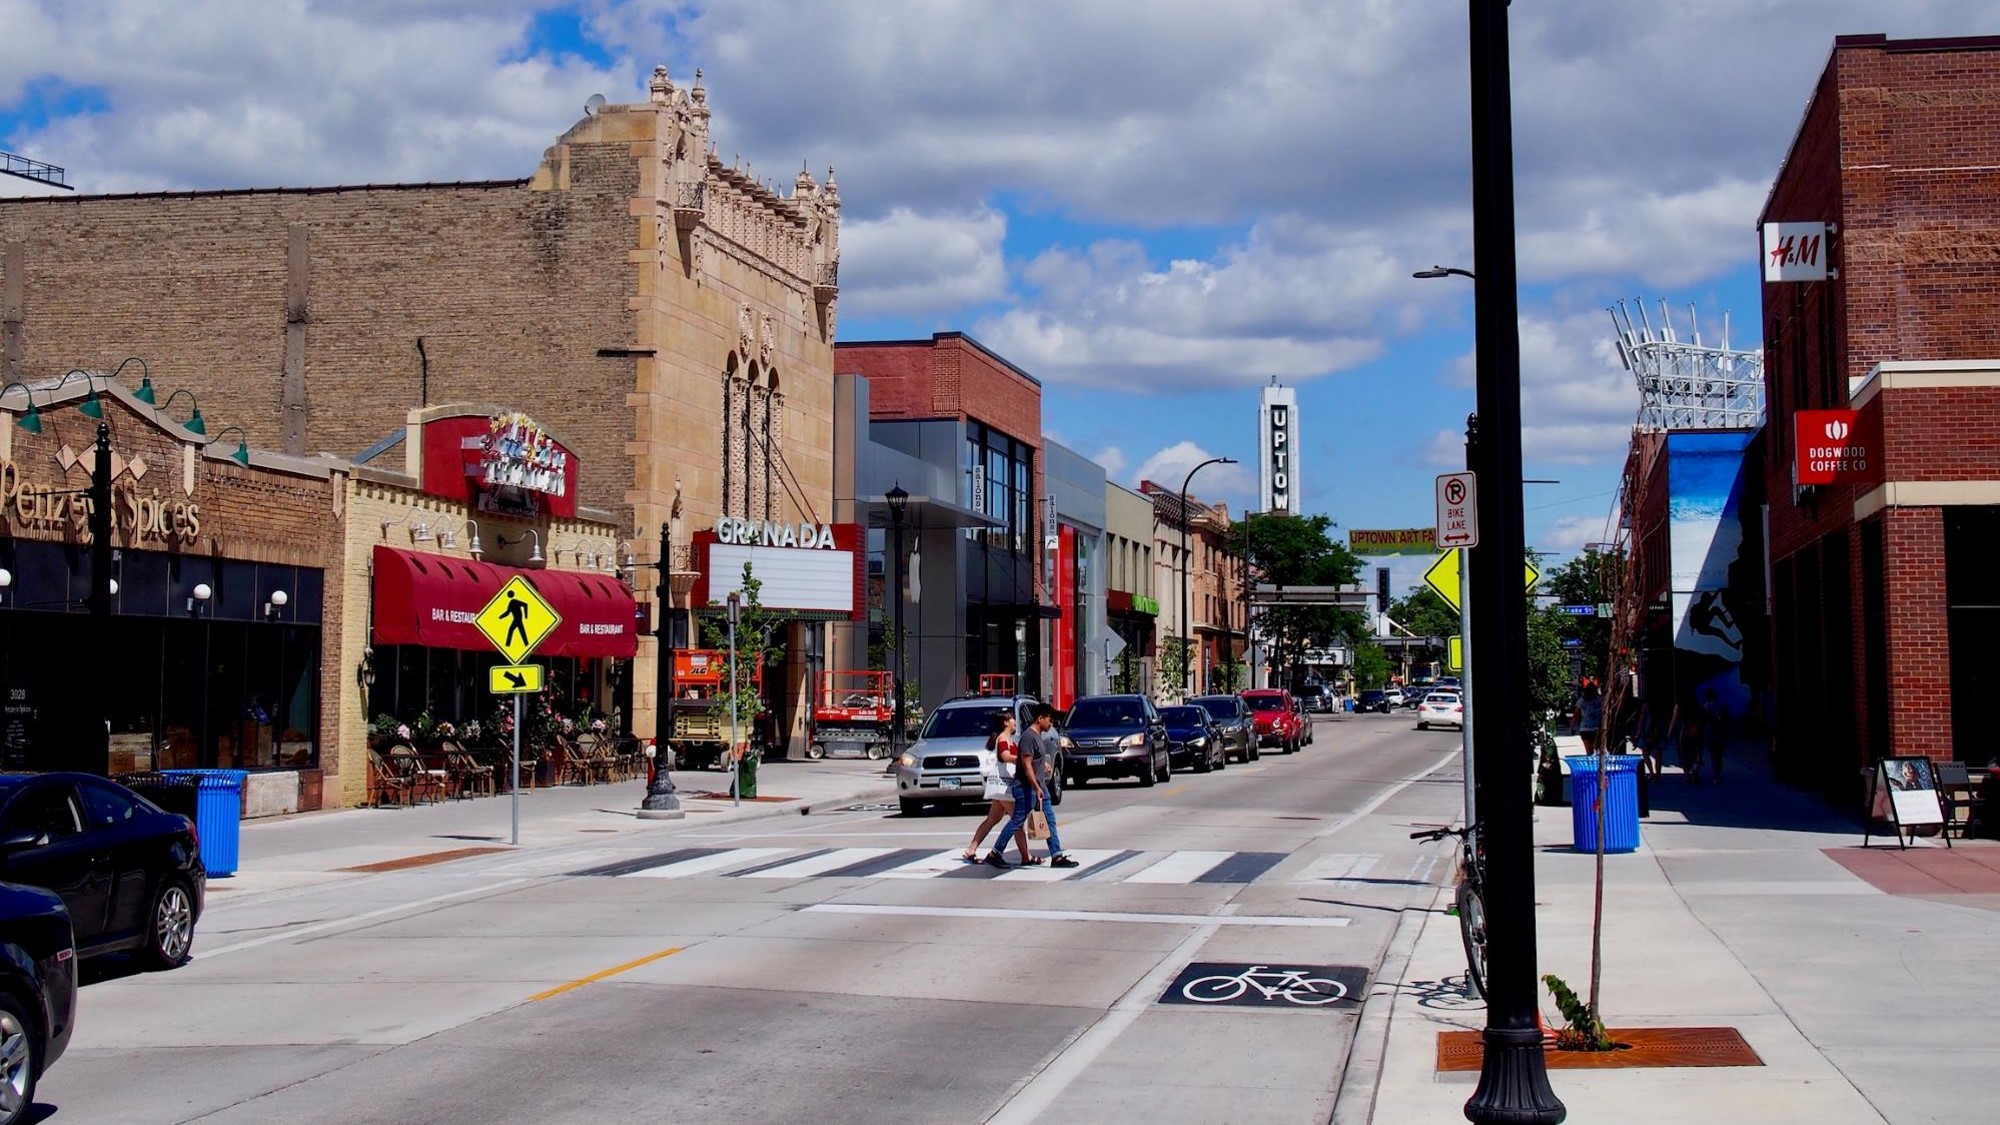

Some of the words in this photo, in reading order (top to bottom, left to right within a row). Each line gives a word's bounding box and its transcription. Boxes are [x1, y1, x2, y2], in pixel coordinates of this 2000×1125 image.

[1771, 234, 1820, 268] H&M
[1810, 447, 1866, 458] DOGWOOD
[1273, 411, 1288, 509] UPTOW
[1811, 460, 1848, 471] COFFEE
[1853, 460, 1866, 470] CO
[122, 477, 200, 546] Spices
[1448, 508, 1464, 518] BIKE
[1447, 520, 1466, 531] LANE
[716, 515, 837, 550] GRANADA
[1350, 531, 1396, 544] UPTOWN
[1399, 531, 1419, 543] ART
[432, 608, 445, 620] BAR
[445, 610, 450, 621] &
[580, 623, 590, 633] BAR
[594, 624, 624, 634] RESTAURANT
